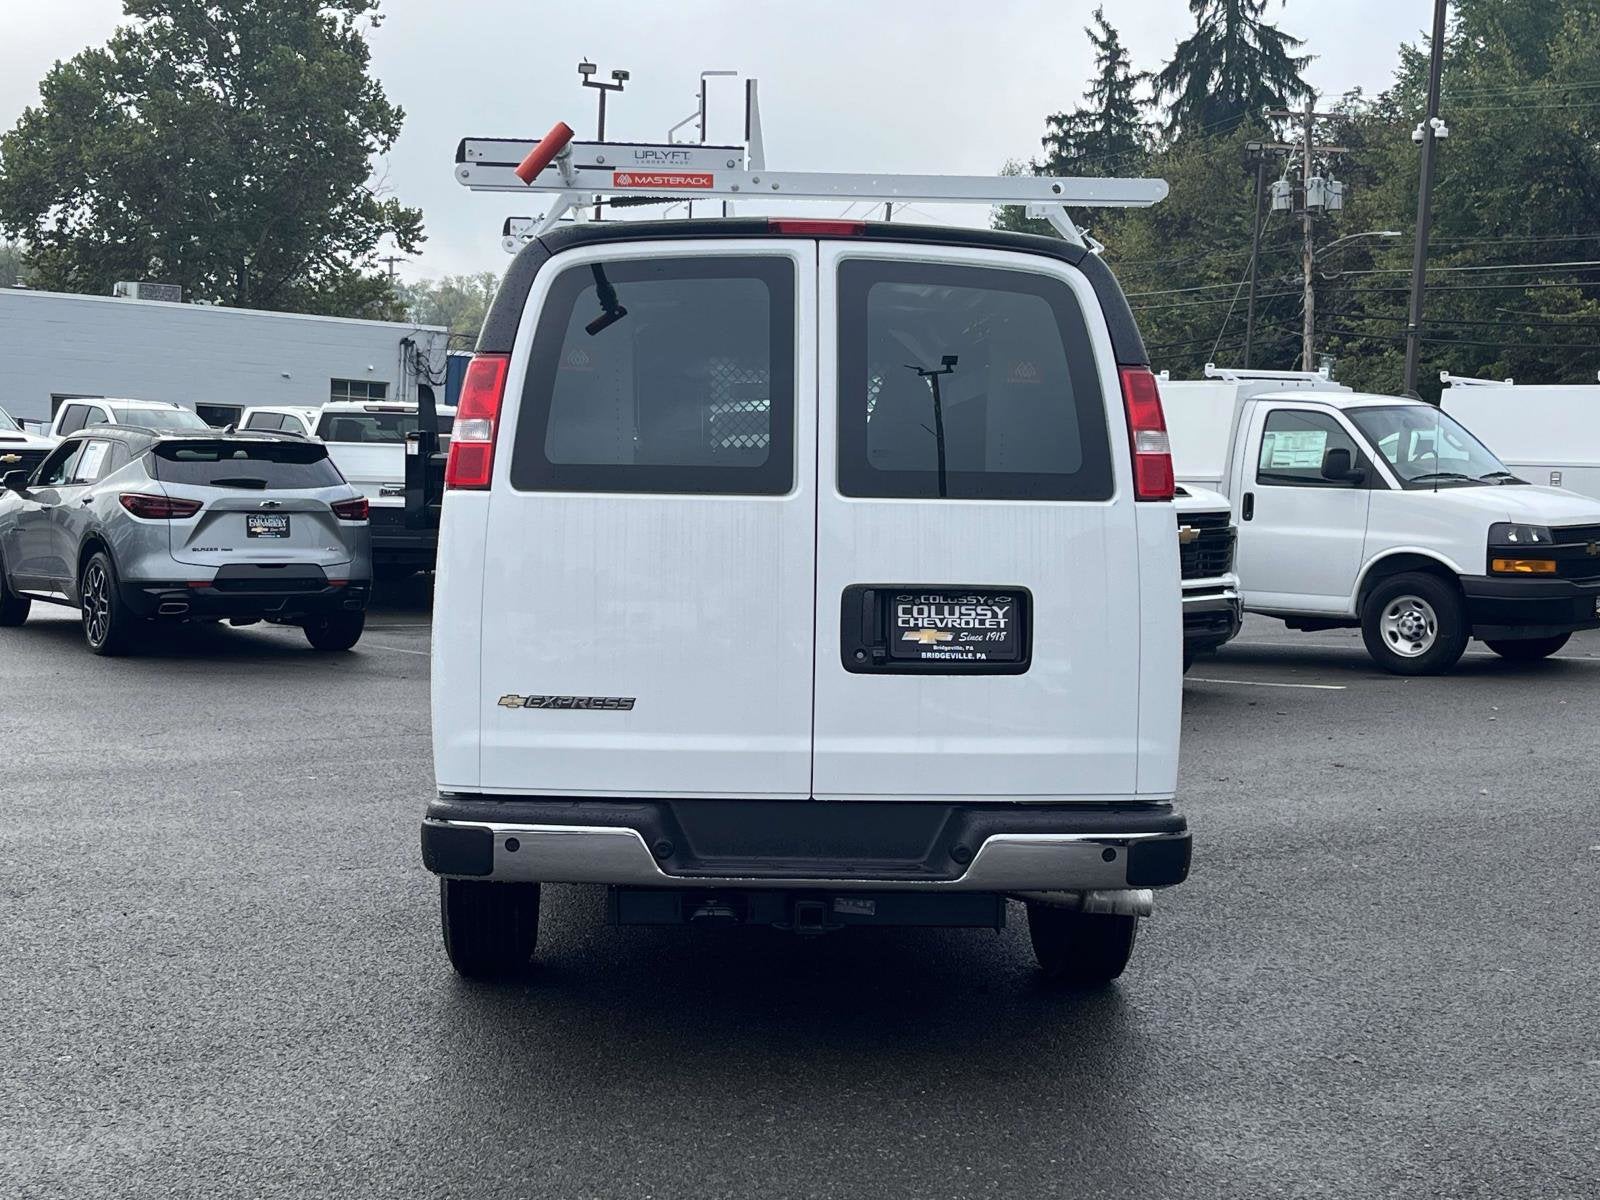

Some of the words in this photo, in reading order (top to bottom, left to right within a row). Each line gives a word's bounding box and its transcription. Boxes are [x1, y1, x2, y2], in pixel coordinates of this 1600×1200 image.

[634, 150, 691, 160] UPLYFT
[634, 176, 709, 185] MASTERACK
[898, 605, 1009, 619] COLUSSY
[898, 618, 1008, 628] CHEVROLET
[958, 632, 983, 642] Since
[985, 631, 1008, 642] 1918
[524, 695, 636, 710] EXPRESS
